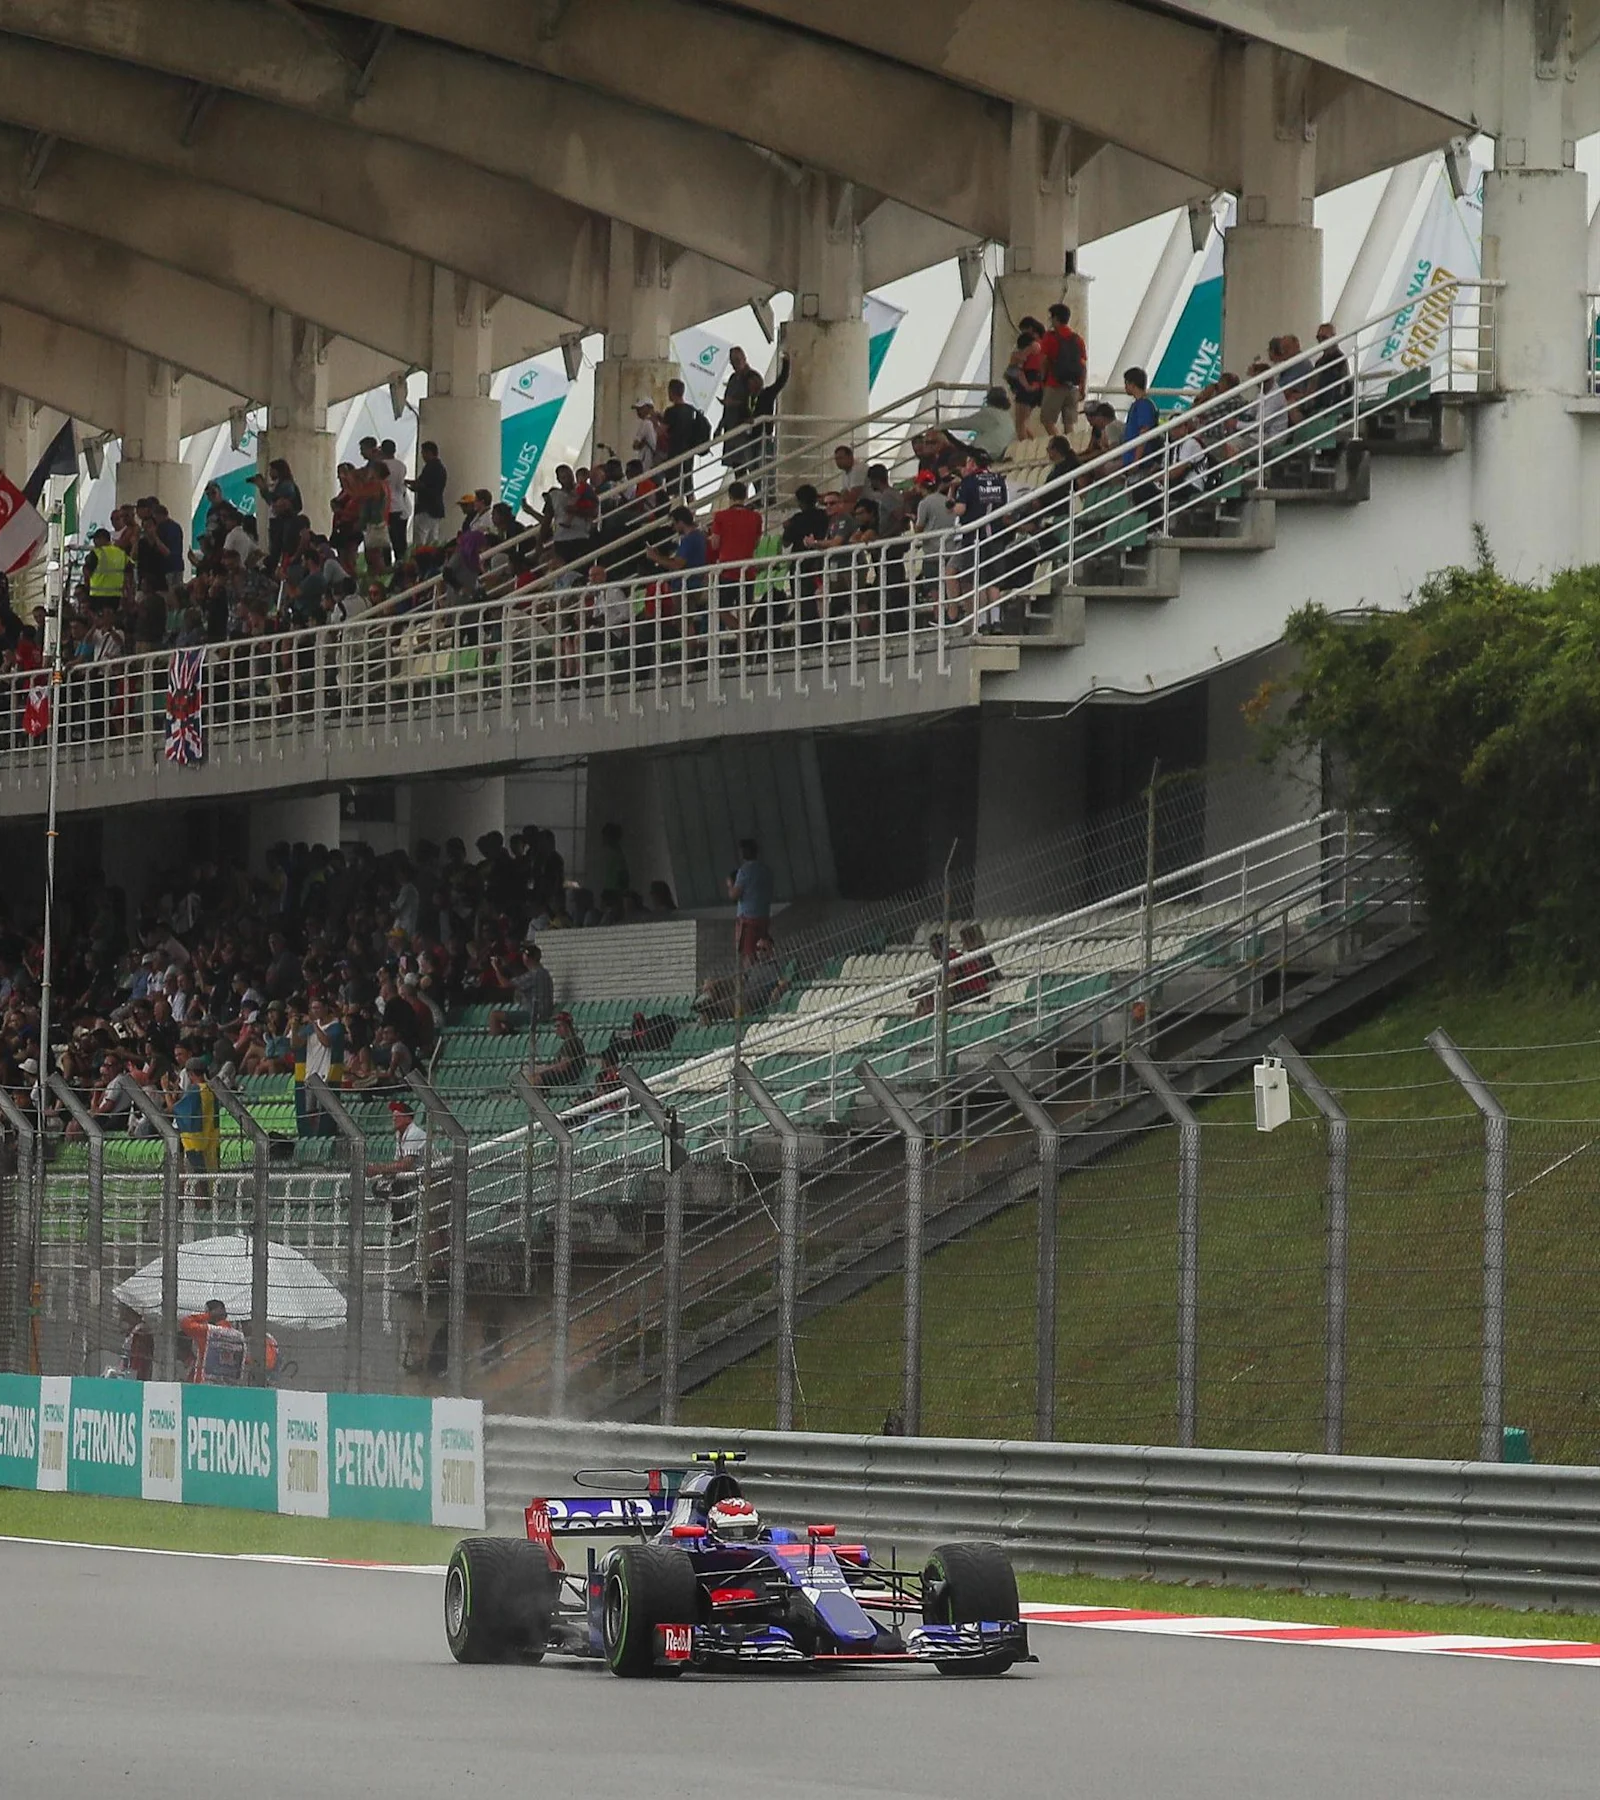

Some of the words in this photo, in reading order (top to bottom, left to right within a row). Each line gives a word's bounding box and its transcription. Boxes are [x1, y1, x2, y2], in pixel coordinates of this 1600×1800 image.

[72, 1407, 137, 1467] PETRONAS
[187, 1415, 271, 1478] PETRONAS
[287, 1418, 318, 1442] PETRONAS
[334, 1427, 425, 1492] PETRONAS
